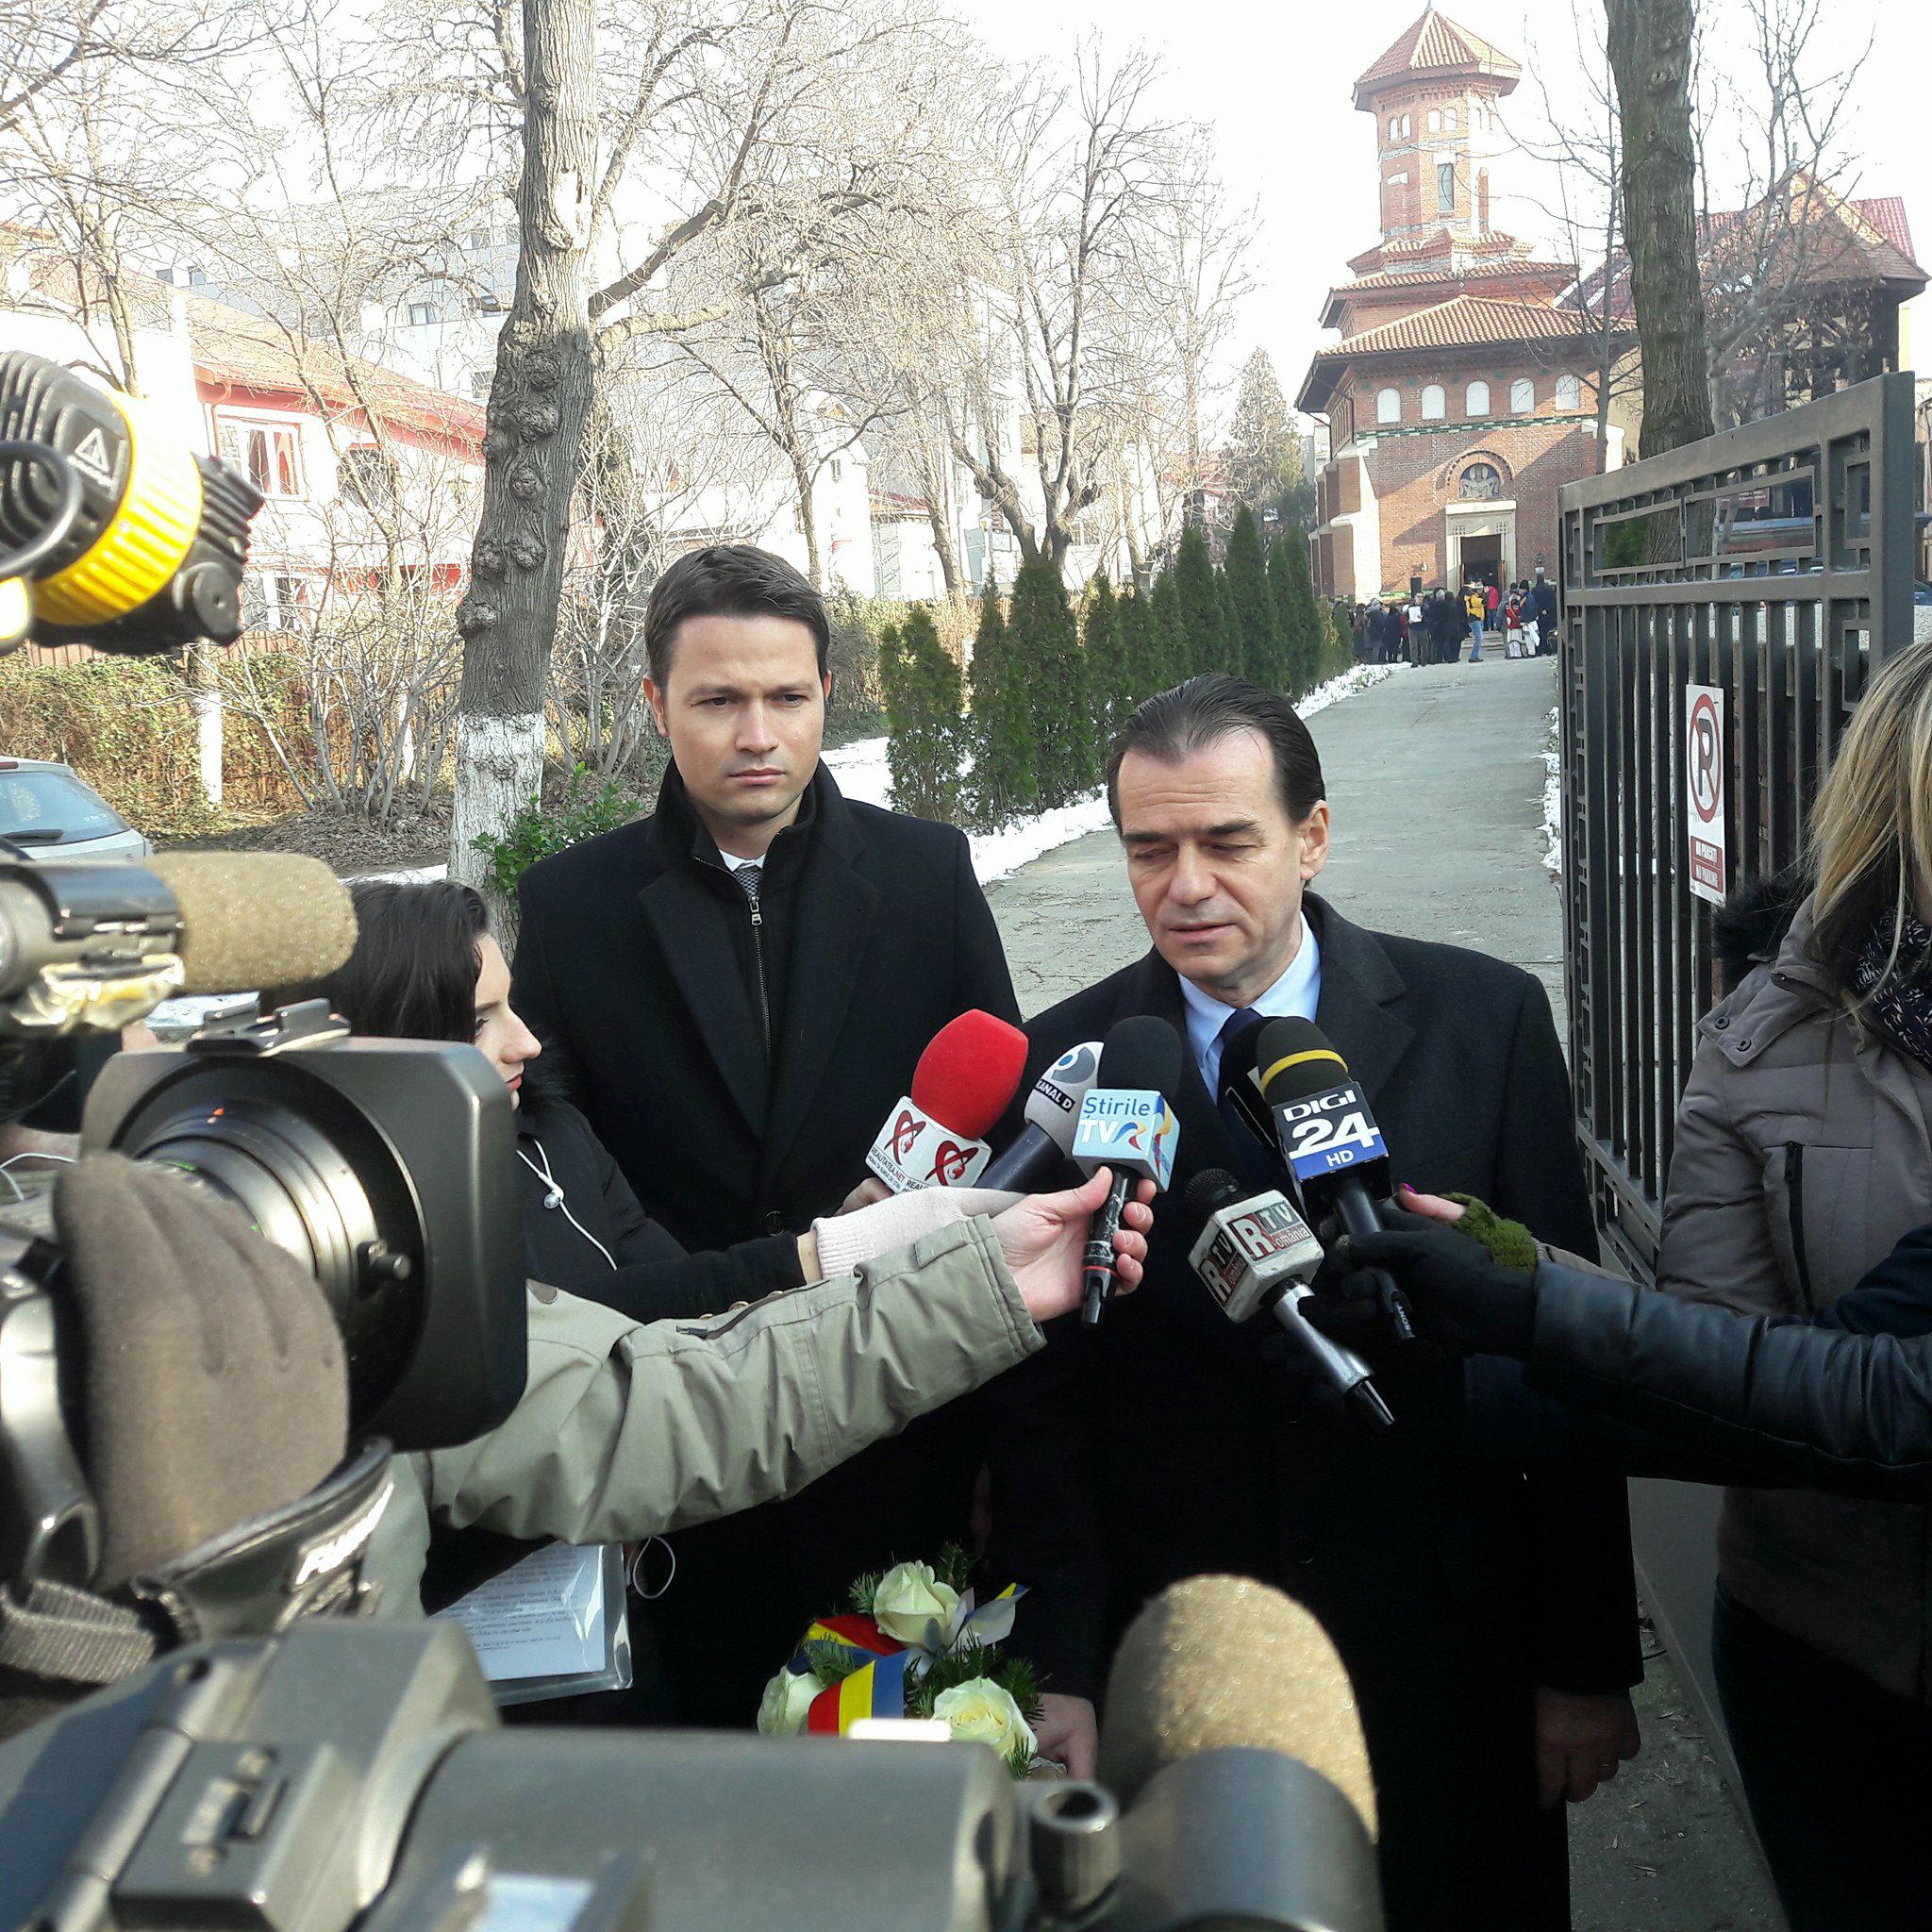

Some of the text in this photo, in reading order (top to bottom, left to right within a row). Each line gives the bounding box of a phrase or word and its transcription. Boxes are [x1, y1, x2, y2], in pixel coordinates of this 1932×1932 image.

[1061, 1098, 1073, 1109] D
[1283, 1090, 1357, 1122] DIGI
[1079, 1119, 1121, 1145] TV
[1289, 1111, 1381, 1160] 24
[1325, 1149, 1355, 1167] HD
